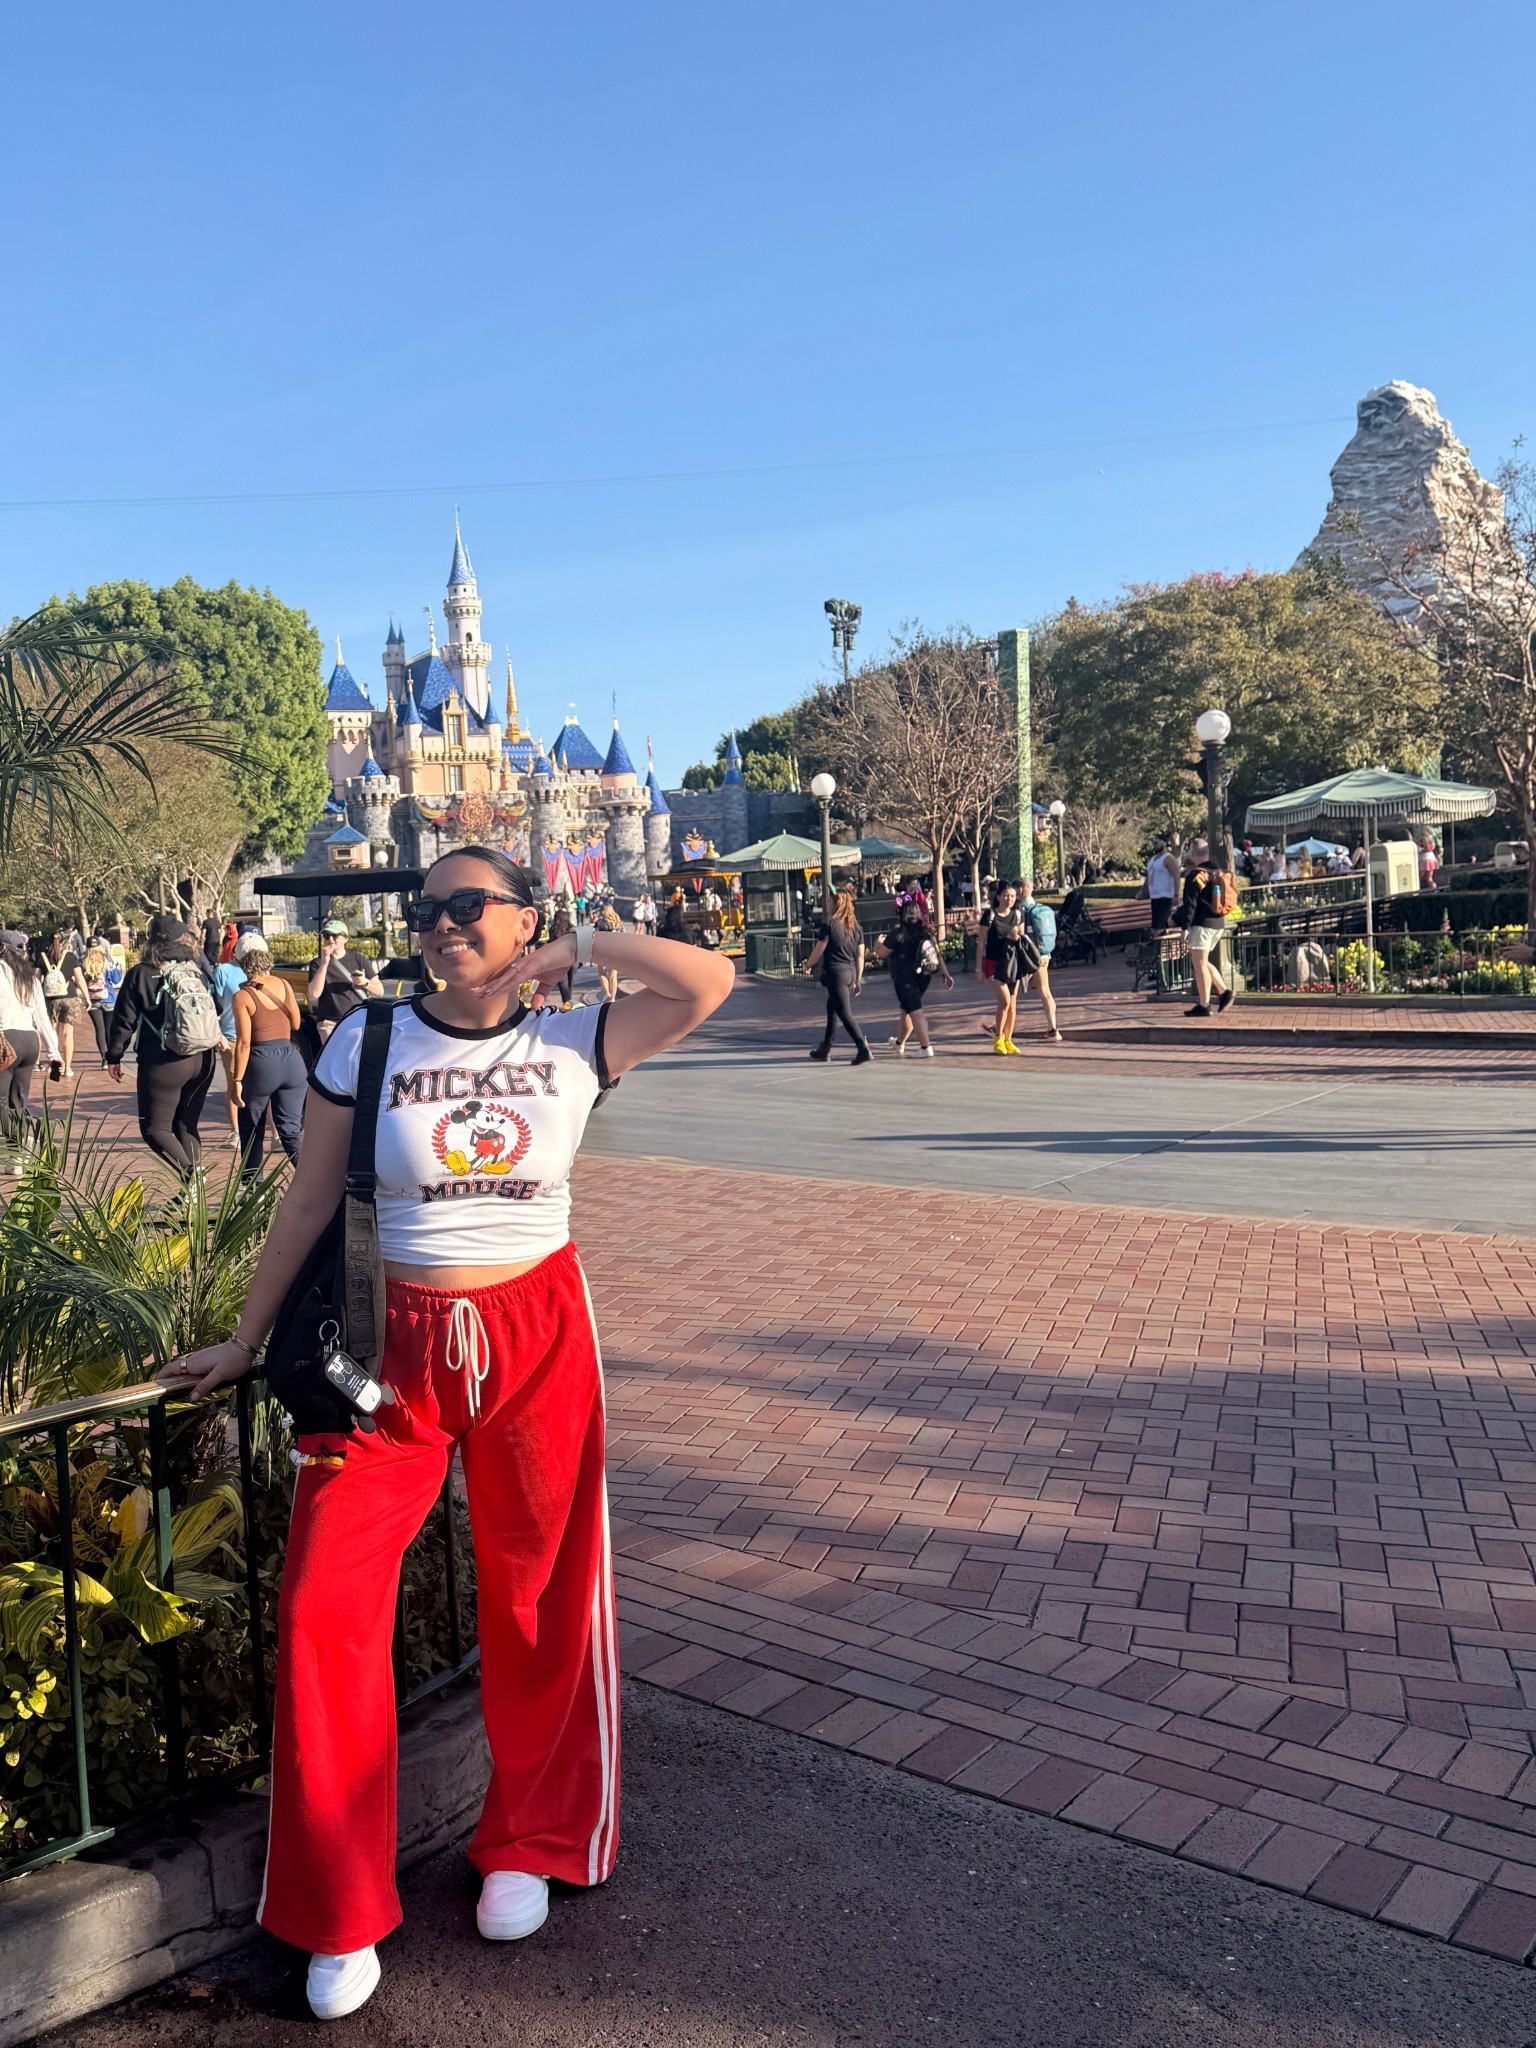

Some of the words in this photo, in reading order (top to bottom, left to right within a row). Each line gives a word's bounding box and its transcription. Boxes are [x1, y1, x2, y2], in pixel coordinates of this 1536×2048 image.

[386, 1061, 559, 1111] MICKEY
[419, 1178, 542, 1203] MOUSE
[349, 1240, 371, 1328] BAGGU
